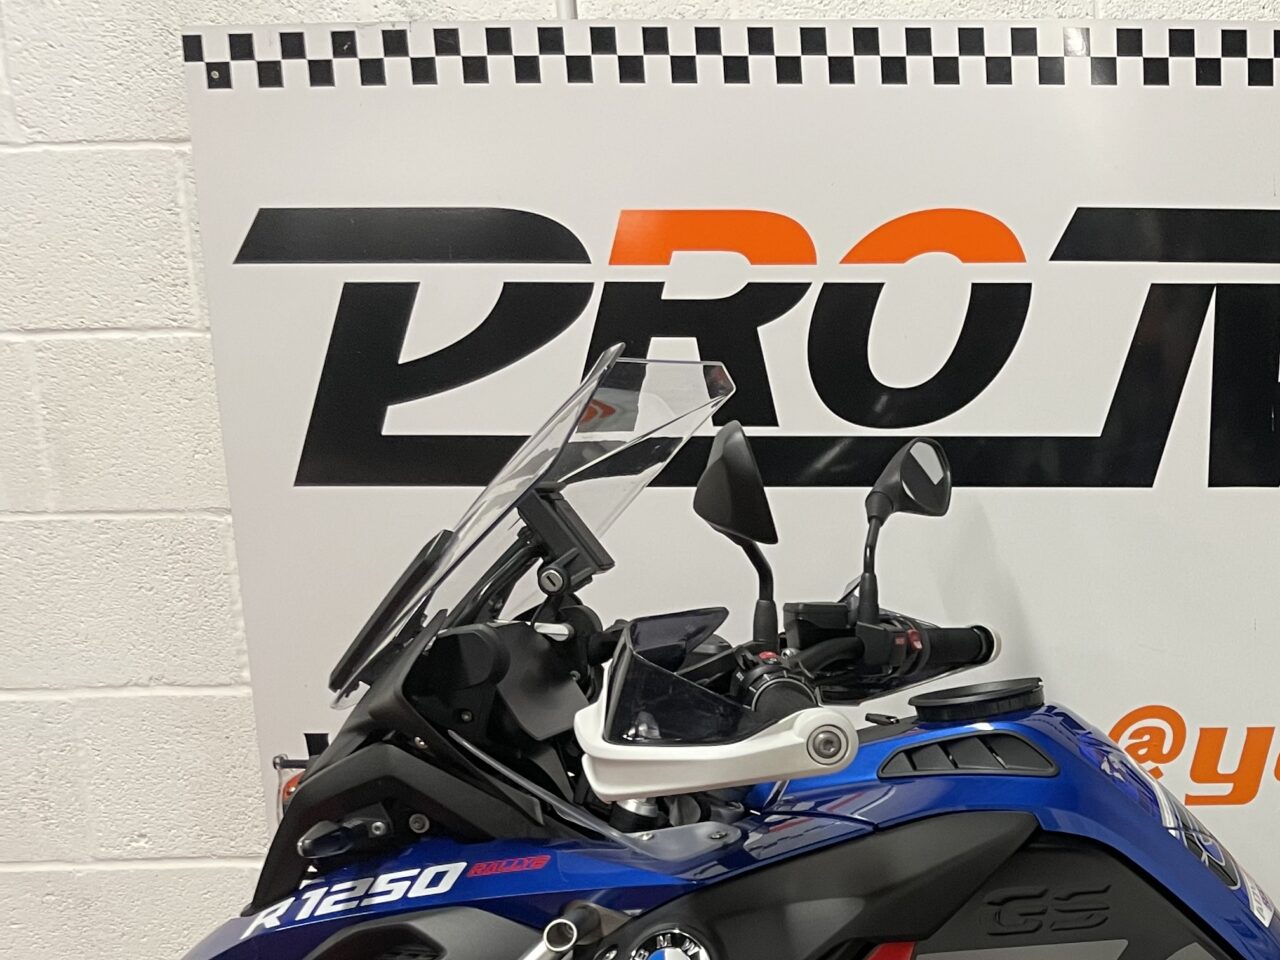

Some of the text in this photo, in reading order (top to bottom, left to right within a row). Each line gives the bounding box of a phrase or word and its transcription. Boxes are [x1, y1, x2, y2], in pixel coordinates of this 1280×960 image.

[233, 206, 1033, 487] PRO
[240, 896, 296, 940] R
[295, 861, 467, 921] 1250
[984, 884, 1111, 936] GS
